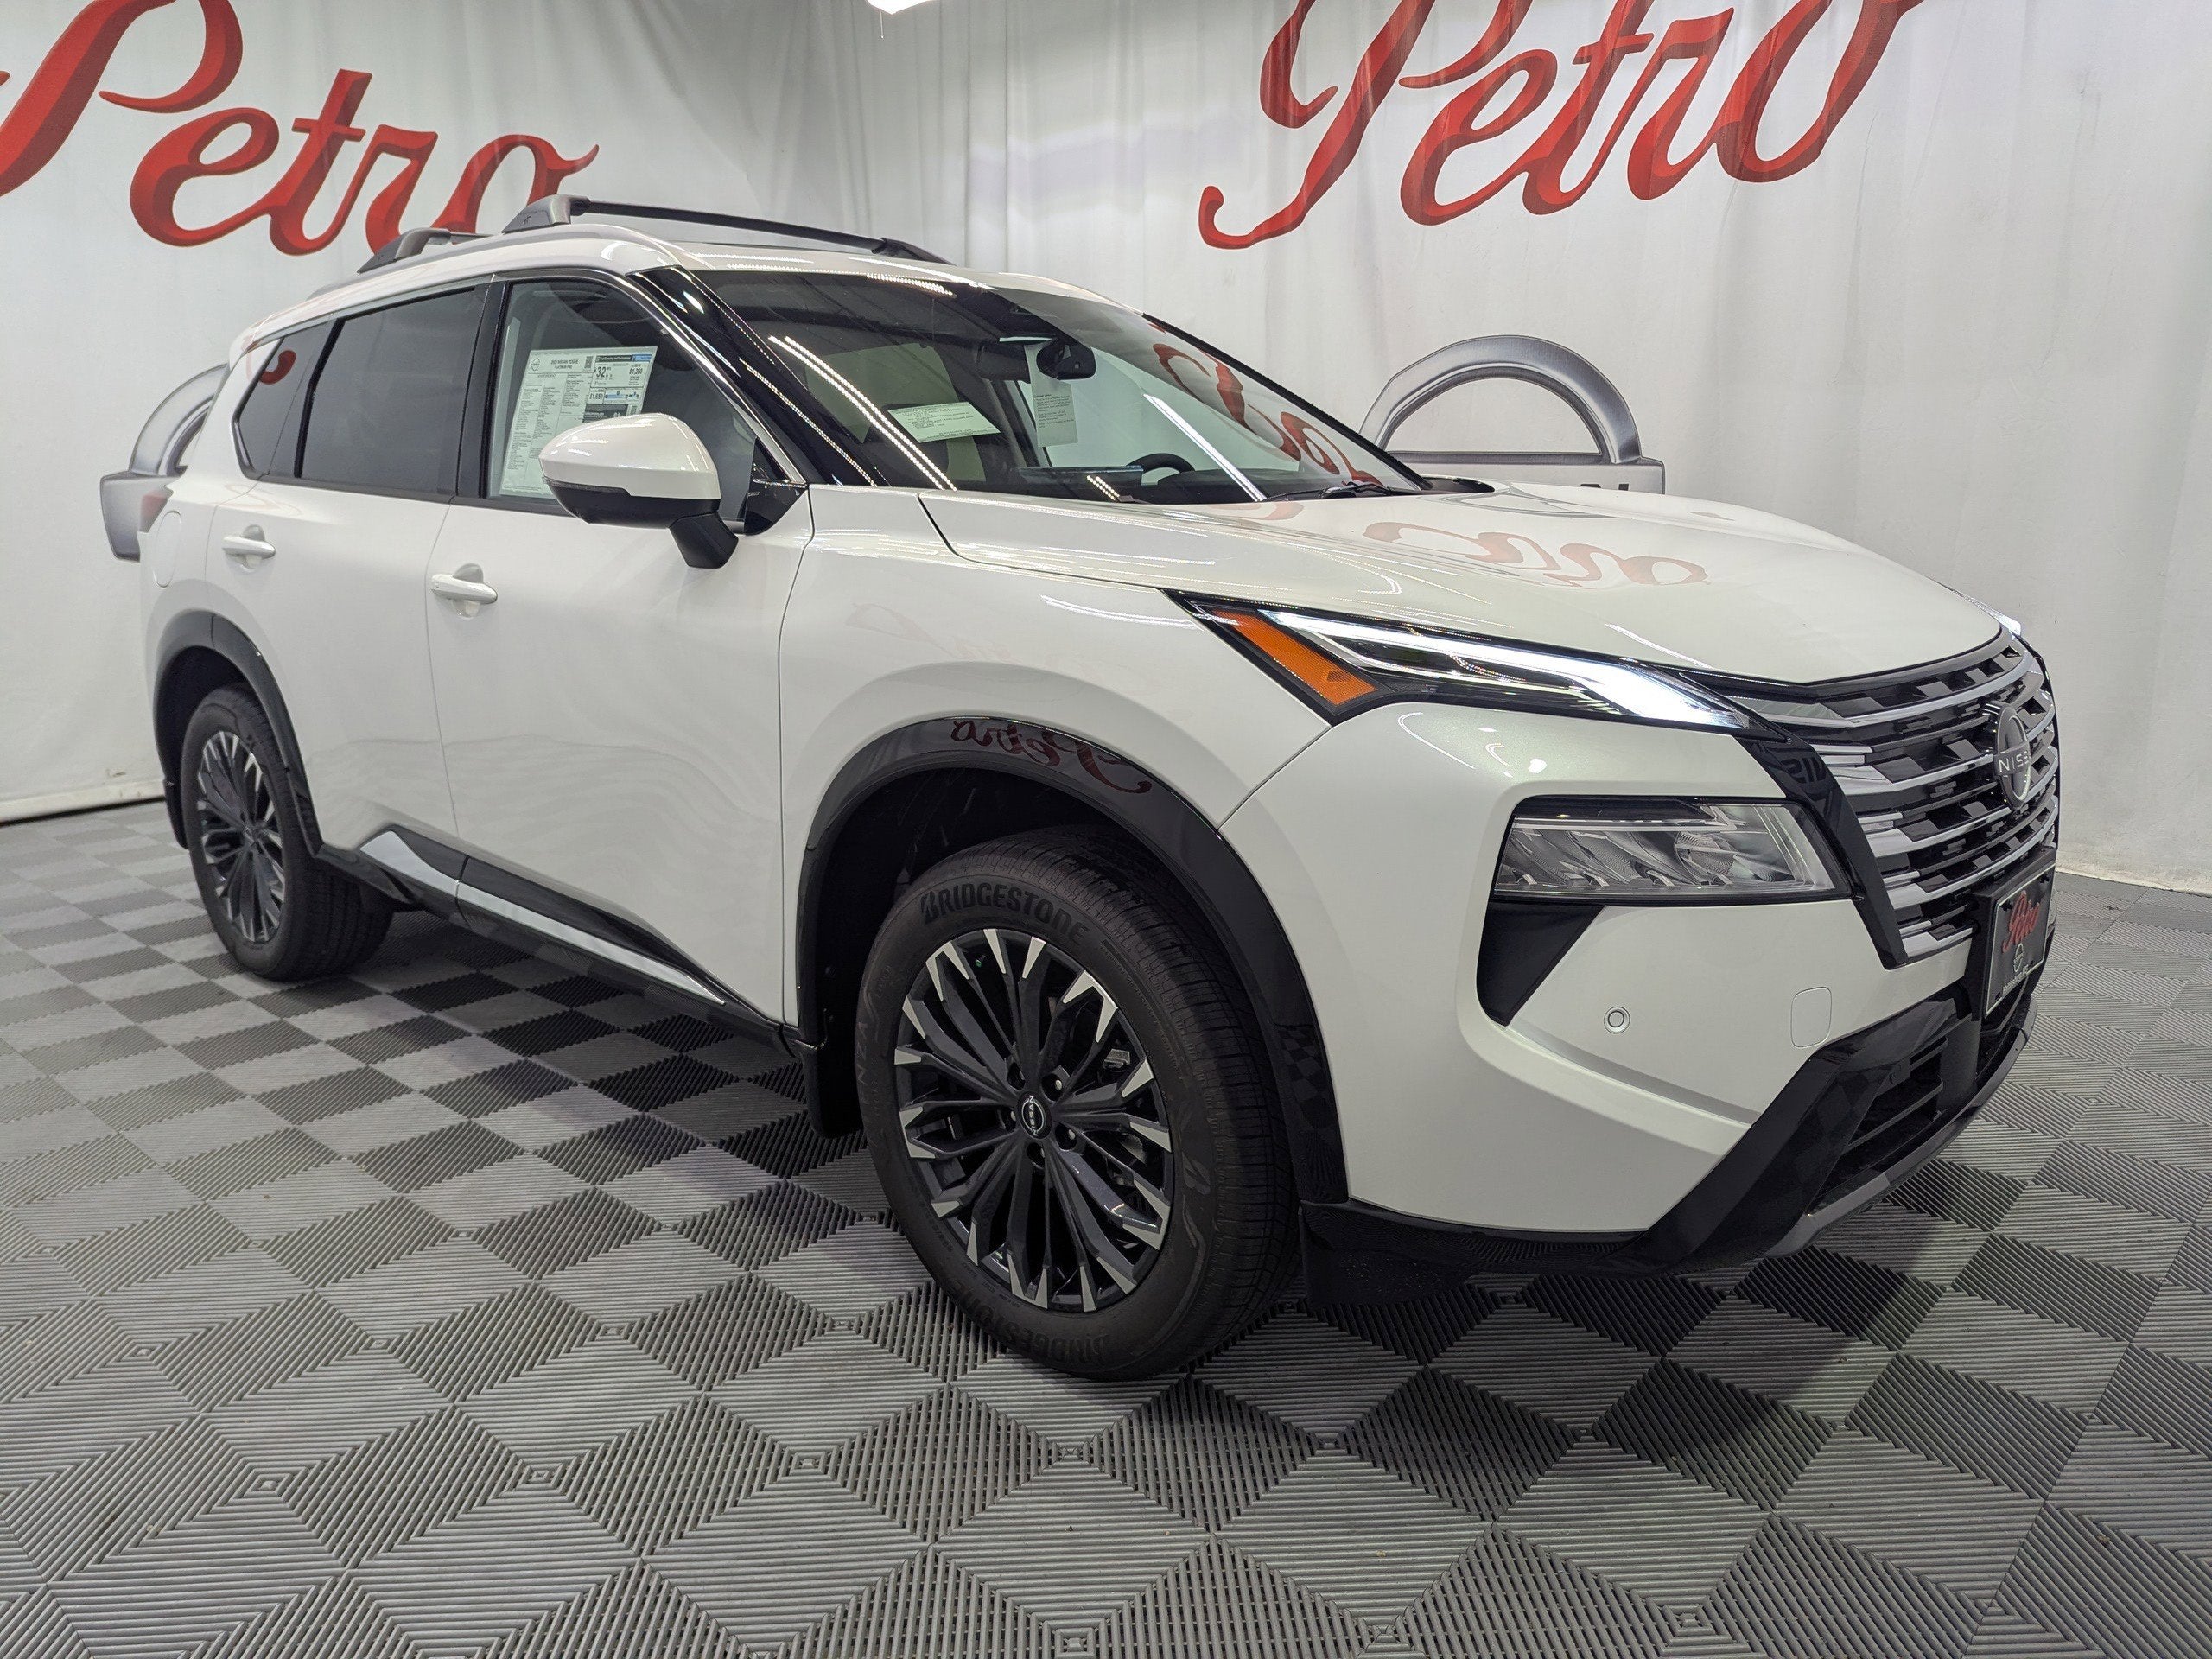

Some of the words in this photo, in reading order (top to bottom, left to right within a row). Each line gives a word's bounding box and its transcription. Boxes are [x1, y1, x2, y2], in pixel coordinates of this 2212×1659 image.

[0, 0, 600, 257] Petro
[1198, 0, 1925, 250] Petro
[920, 882, 1089, 945] BRIDGESTONE
